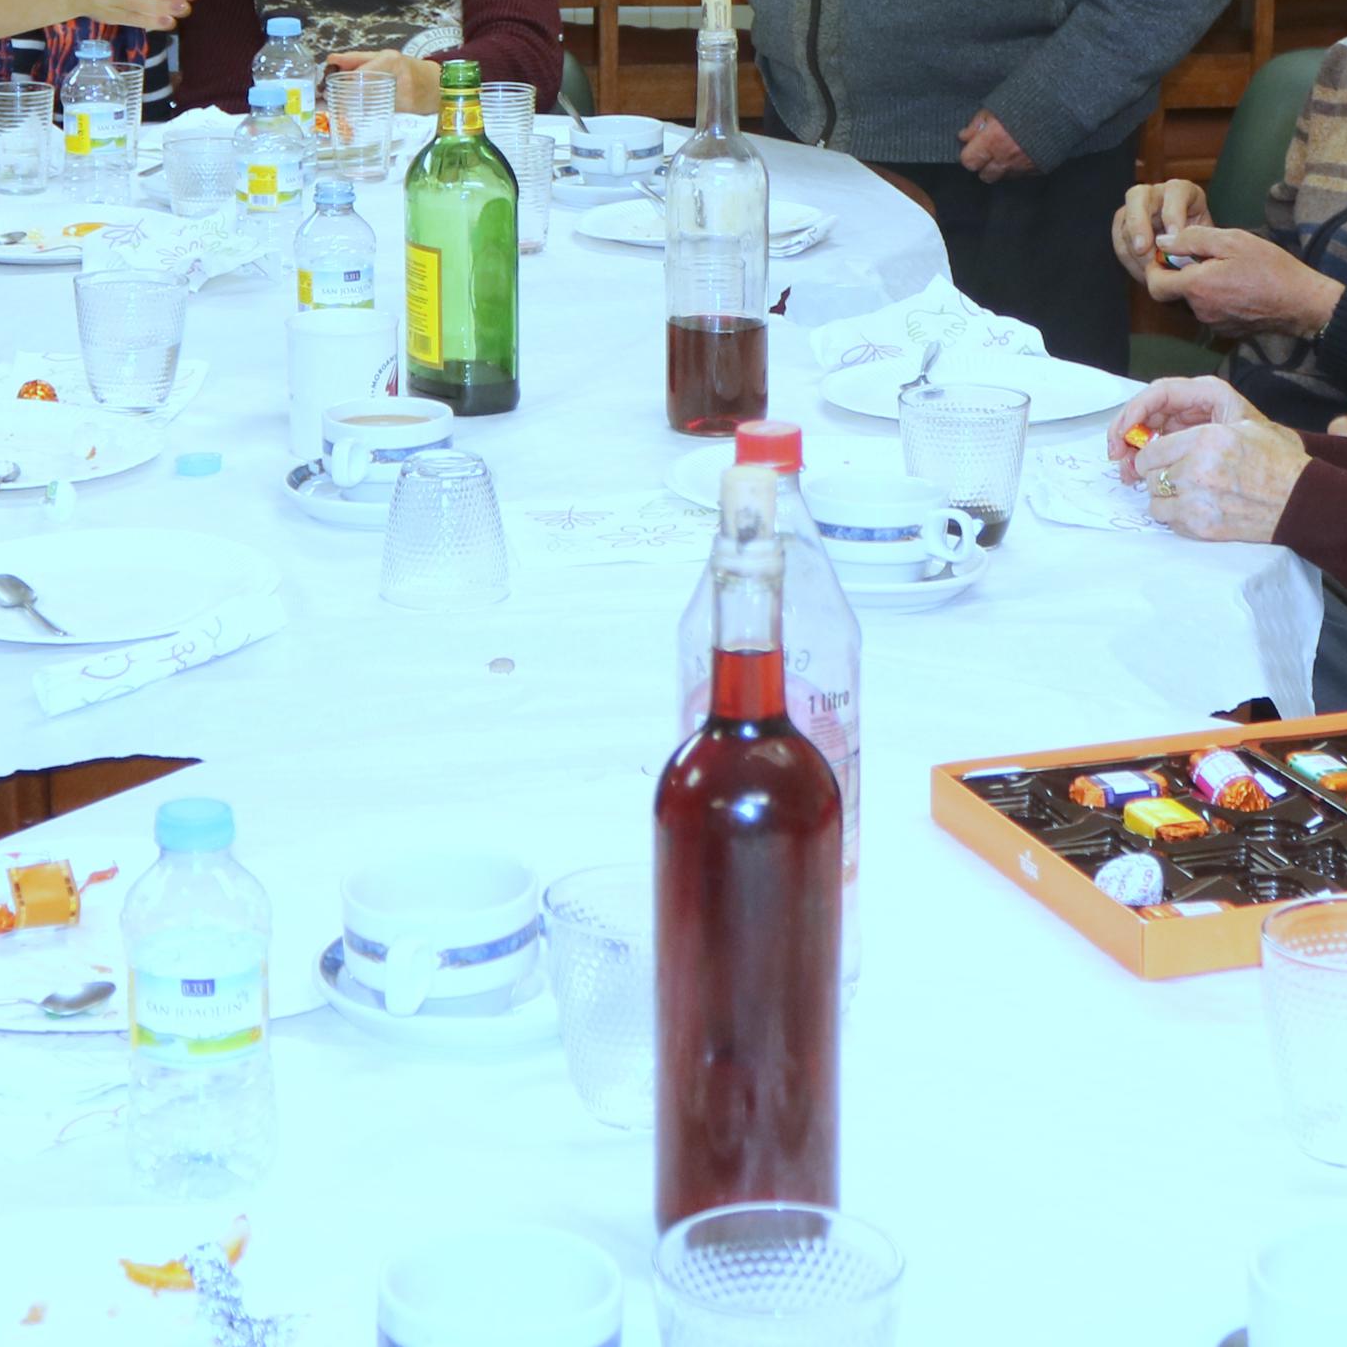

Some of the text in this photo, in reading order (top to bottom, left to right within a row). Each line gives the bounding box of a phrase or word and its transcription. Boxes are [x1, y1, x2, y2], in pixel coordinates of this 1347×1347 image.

[809, 689, 850, 715] 1 litro
[146, 1000, 170, 1016] SAN
